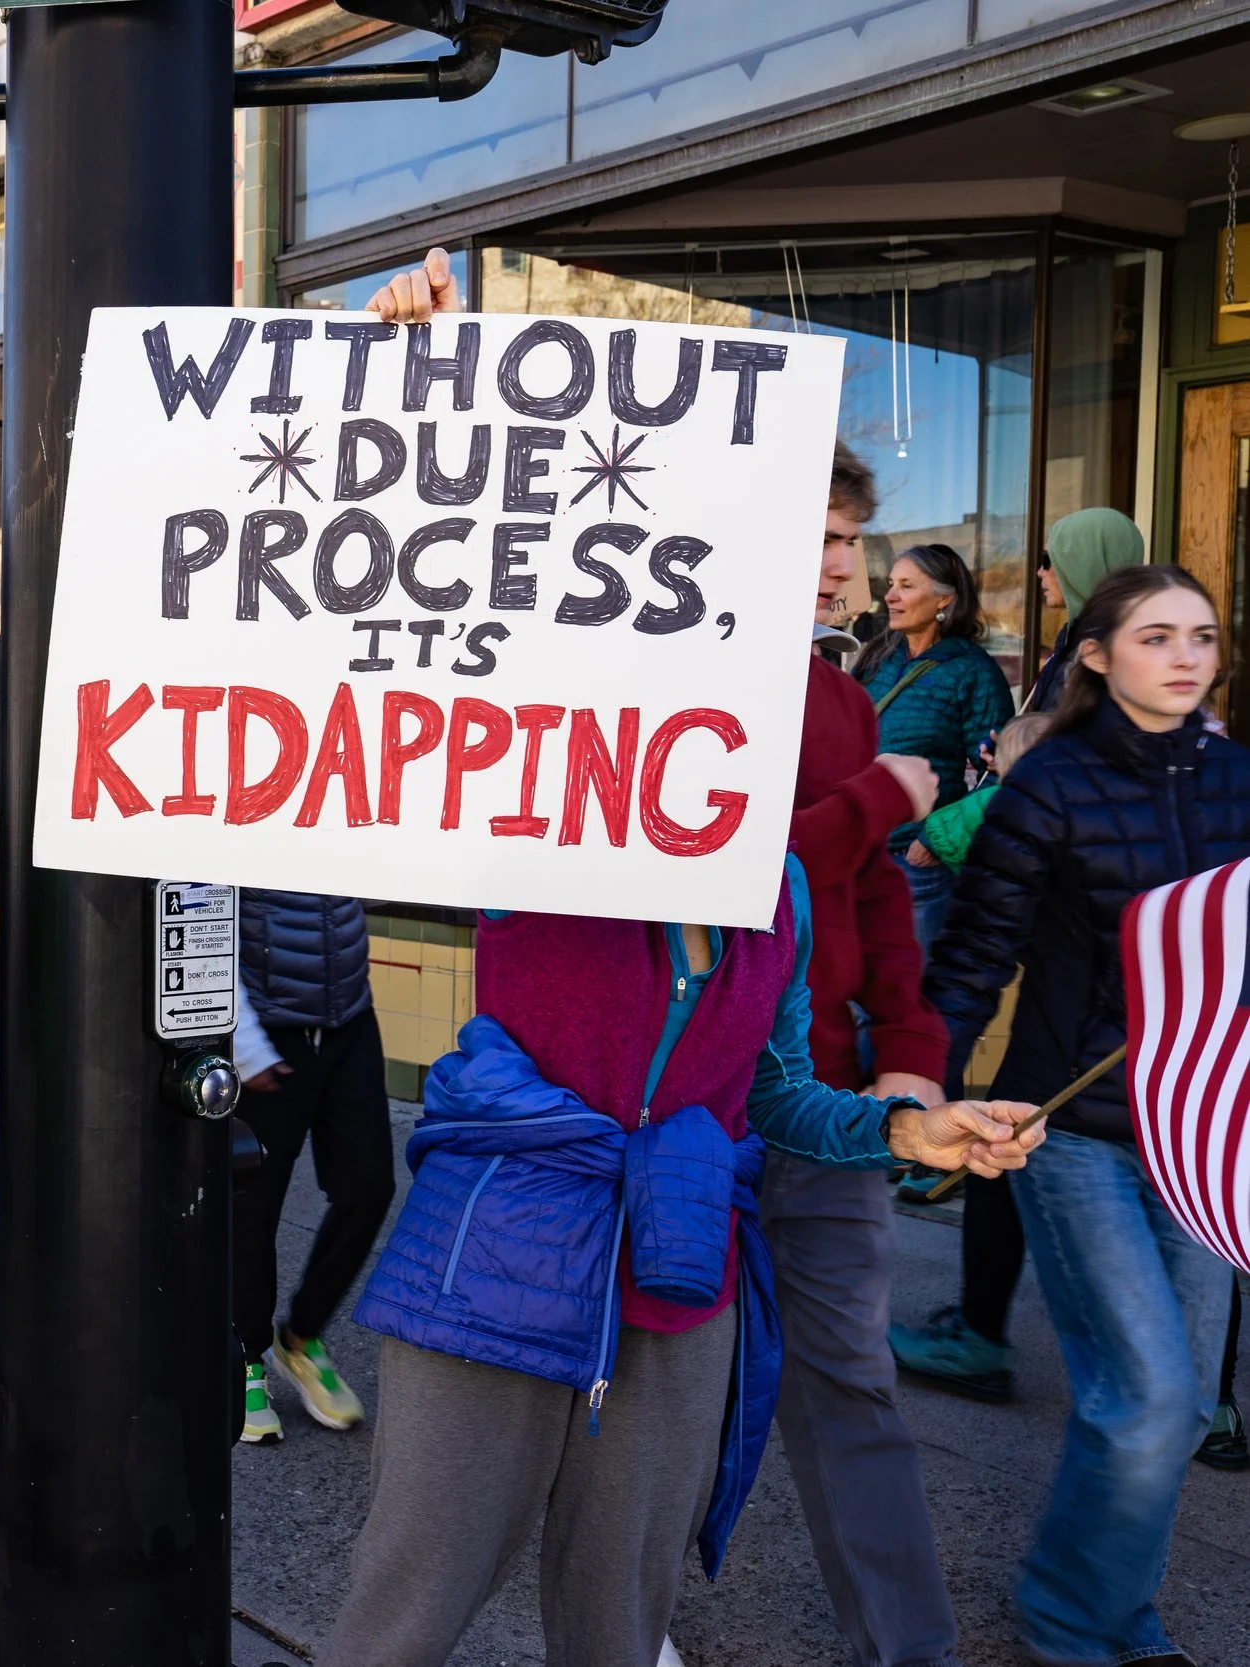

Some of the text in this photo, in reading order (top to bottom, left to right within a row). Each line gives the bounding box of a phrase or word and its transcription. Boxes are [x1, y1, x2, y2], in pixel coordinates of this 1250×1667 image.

[142, 318, 789, 445] WITHOUT
[333, 418, 565, 514] DUE
[161, 507, 735, 641] PROCESS,
[349, 619, 510, 677] IT'S
[72, 679, 749, 857] KIDAPPING
[205, 888, 231, 896] CROSSING
